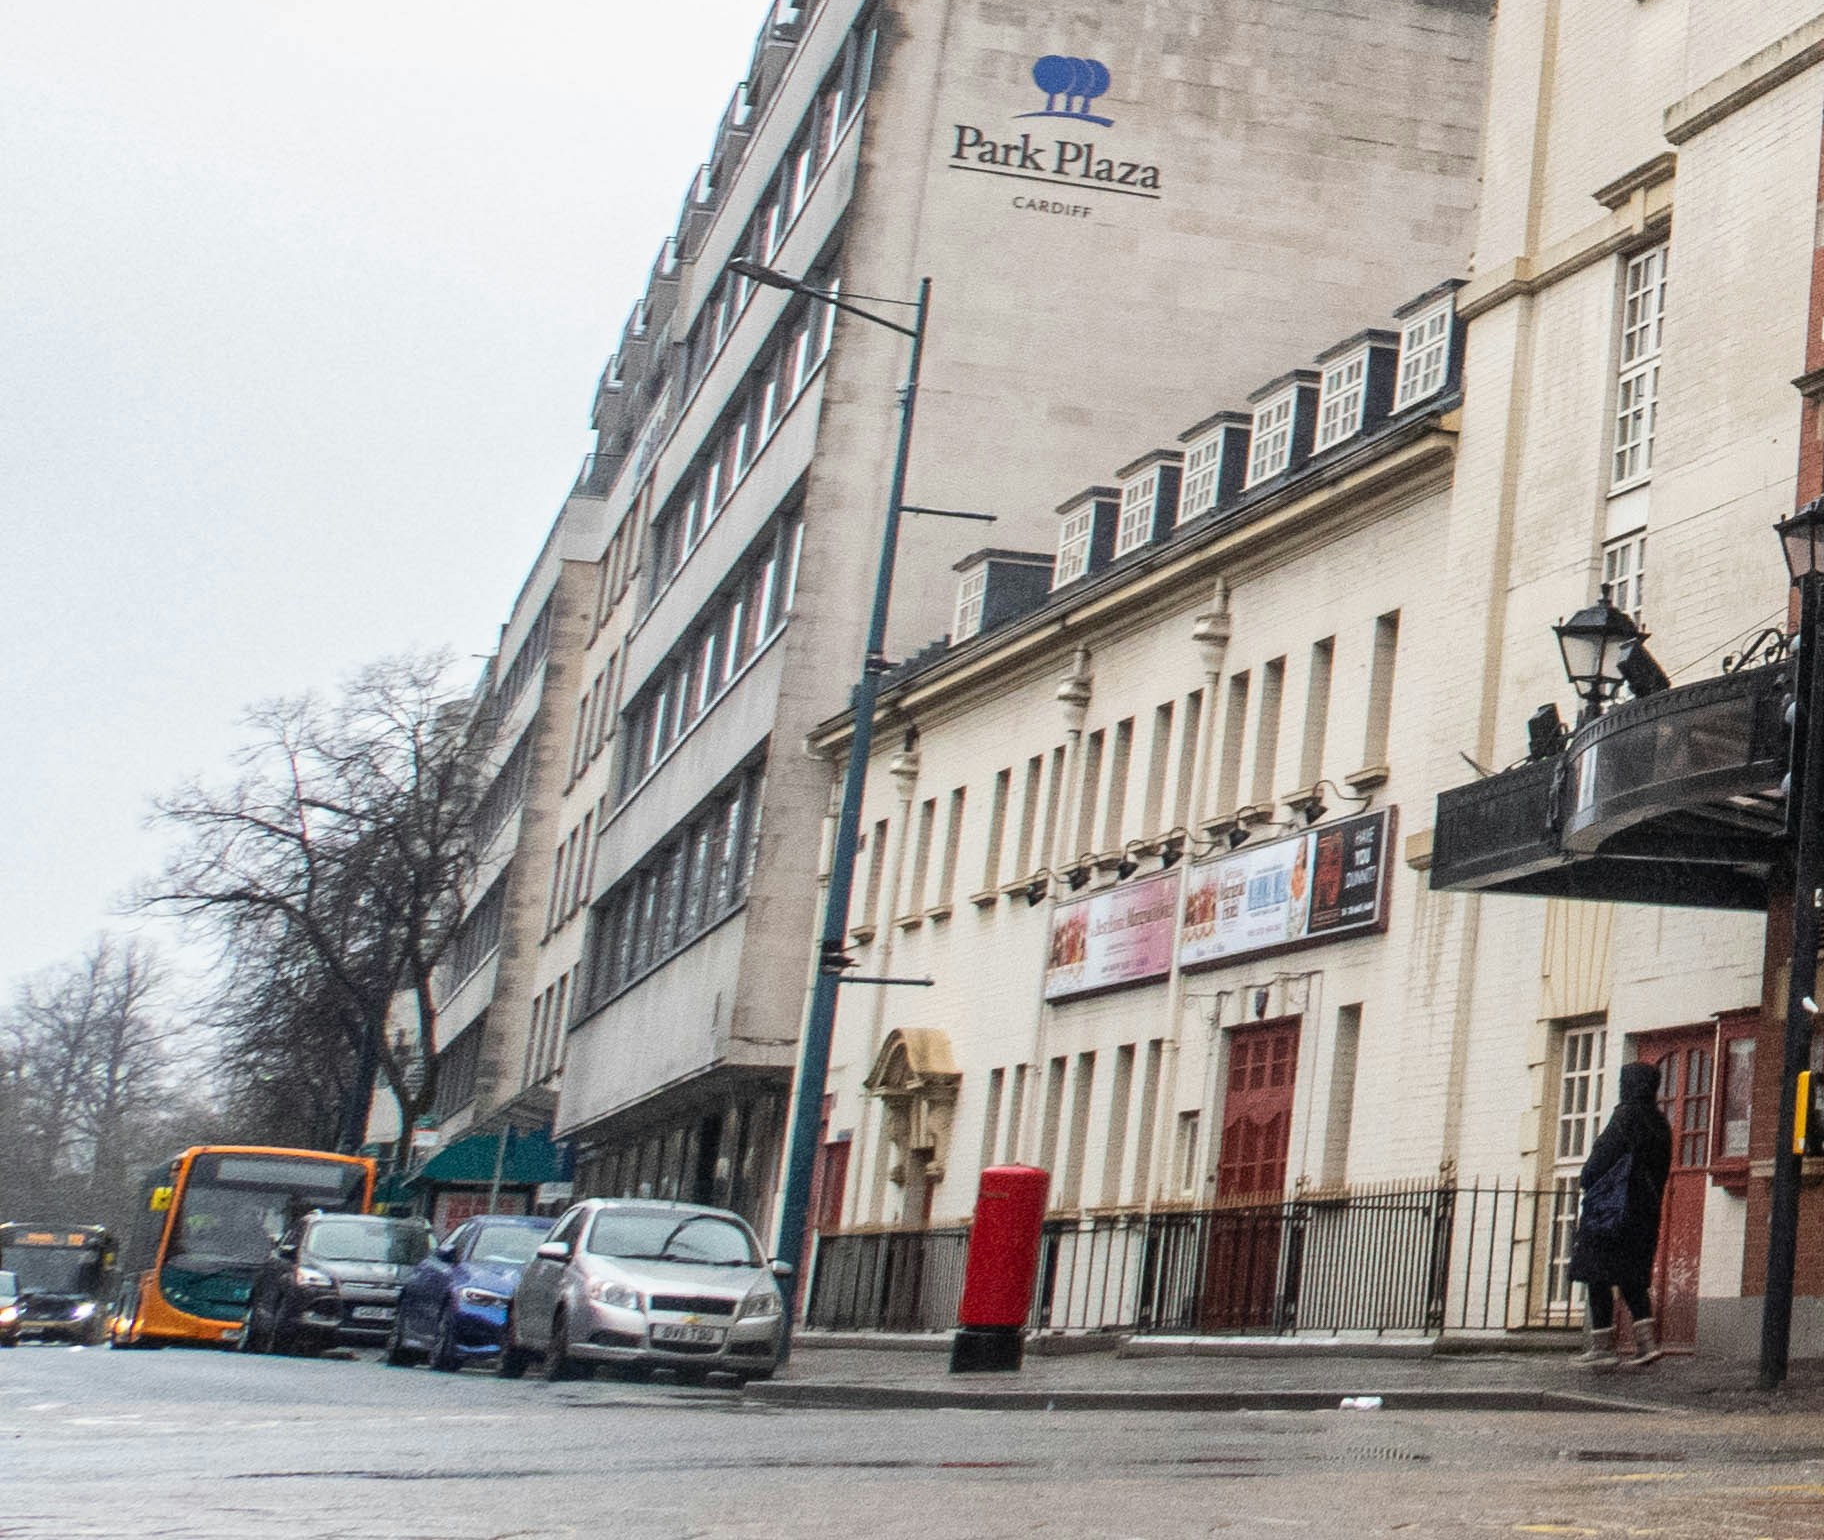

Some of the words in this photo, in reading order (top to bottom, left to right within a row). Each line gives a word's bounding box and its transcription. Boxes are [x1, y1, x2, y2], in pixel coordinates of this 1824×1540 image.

[951, 124, 1047, 171] Park
[1052, 140, 1161, 189] Plaza
[1012, 196, 1093, 218] CARDIFF
